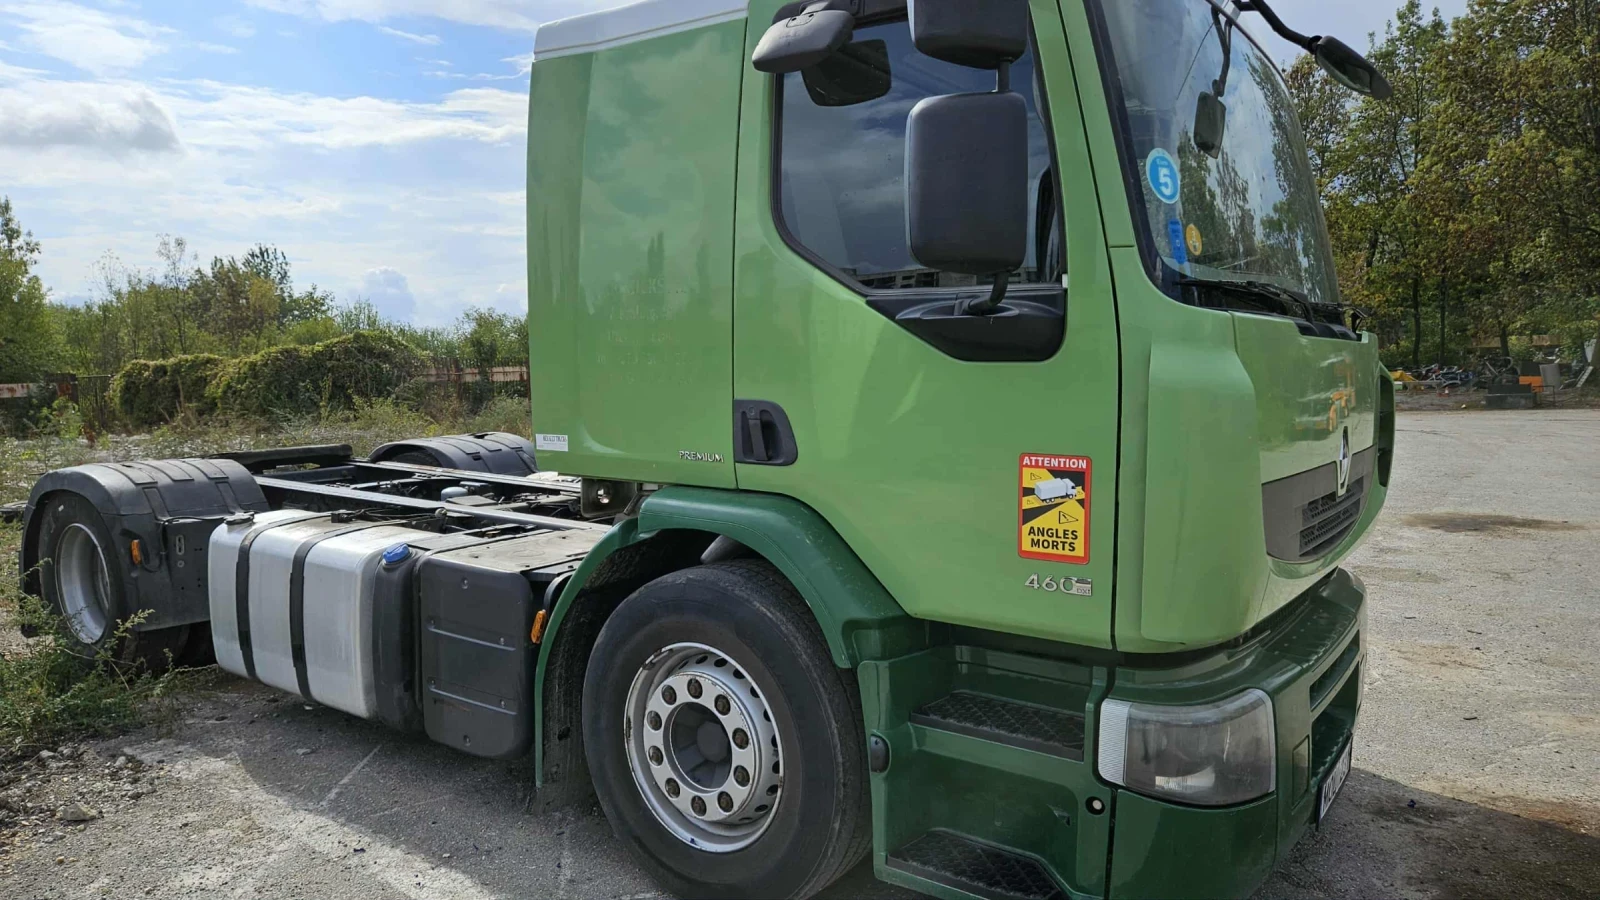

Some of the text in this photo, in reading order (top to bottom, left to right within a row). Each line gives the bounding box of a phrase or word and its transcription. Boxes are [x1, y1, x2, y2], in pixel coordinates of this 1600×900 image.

[1158, 167, 1173, 196] 5
[678, 450, 724, 463] PREMIUM
[1022, 456, 1087, 469] ATTENTION
[1028, 526, 1078, 540] ANGLES
[1030, 538, 1076, 552] MORTS
[1024, 572, 1074, 594] 460
